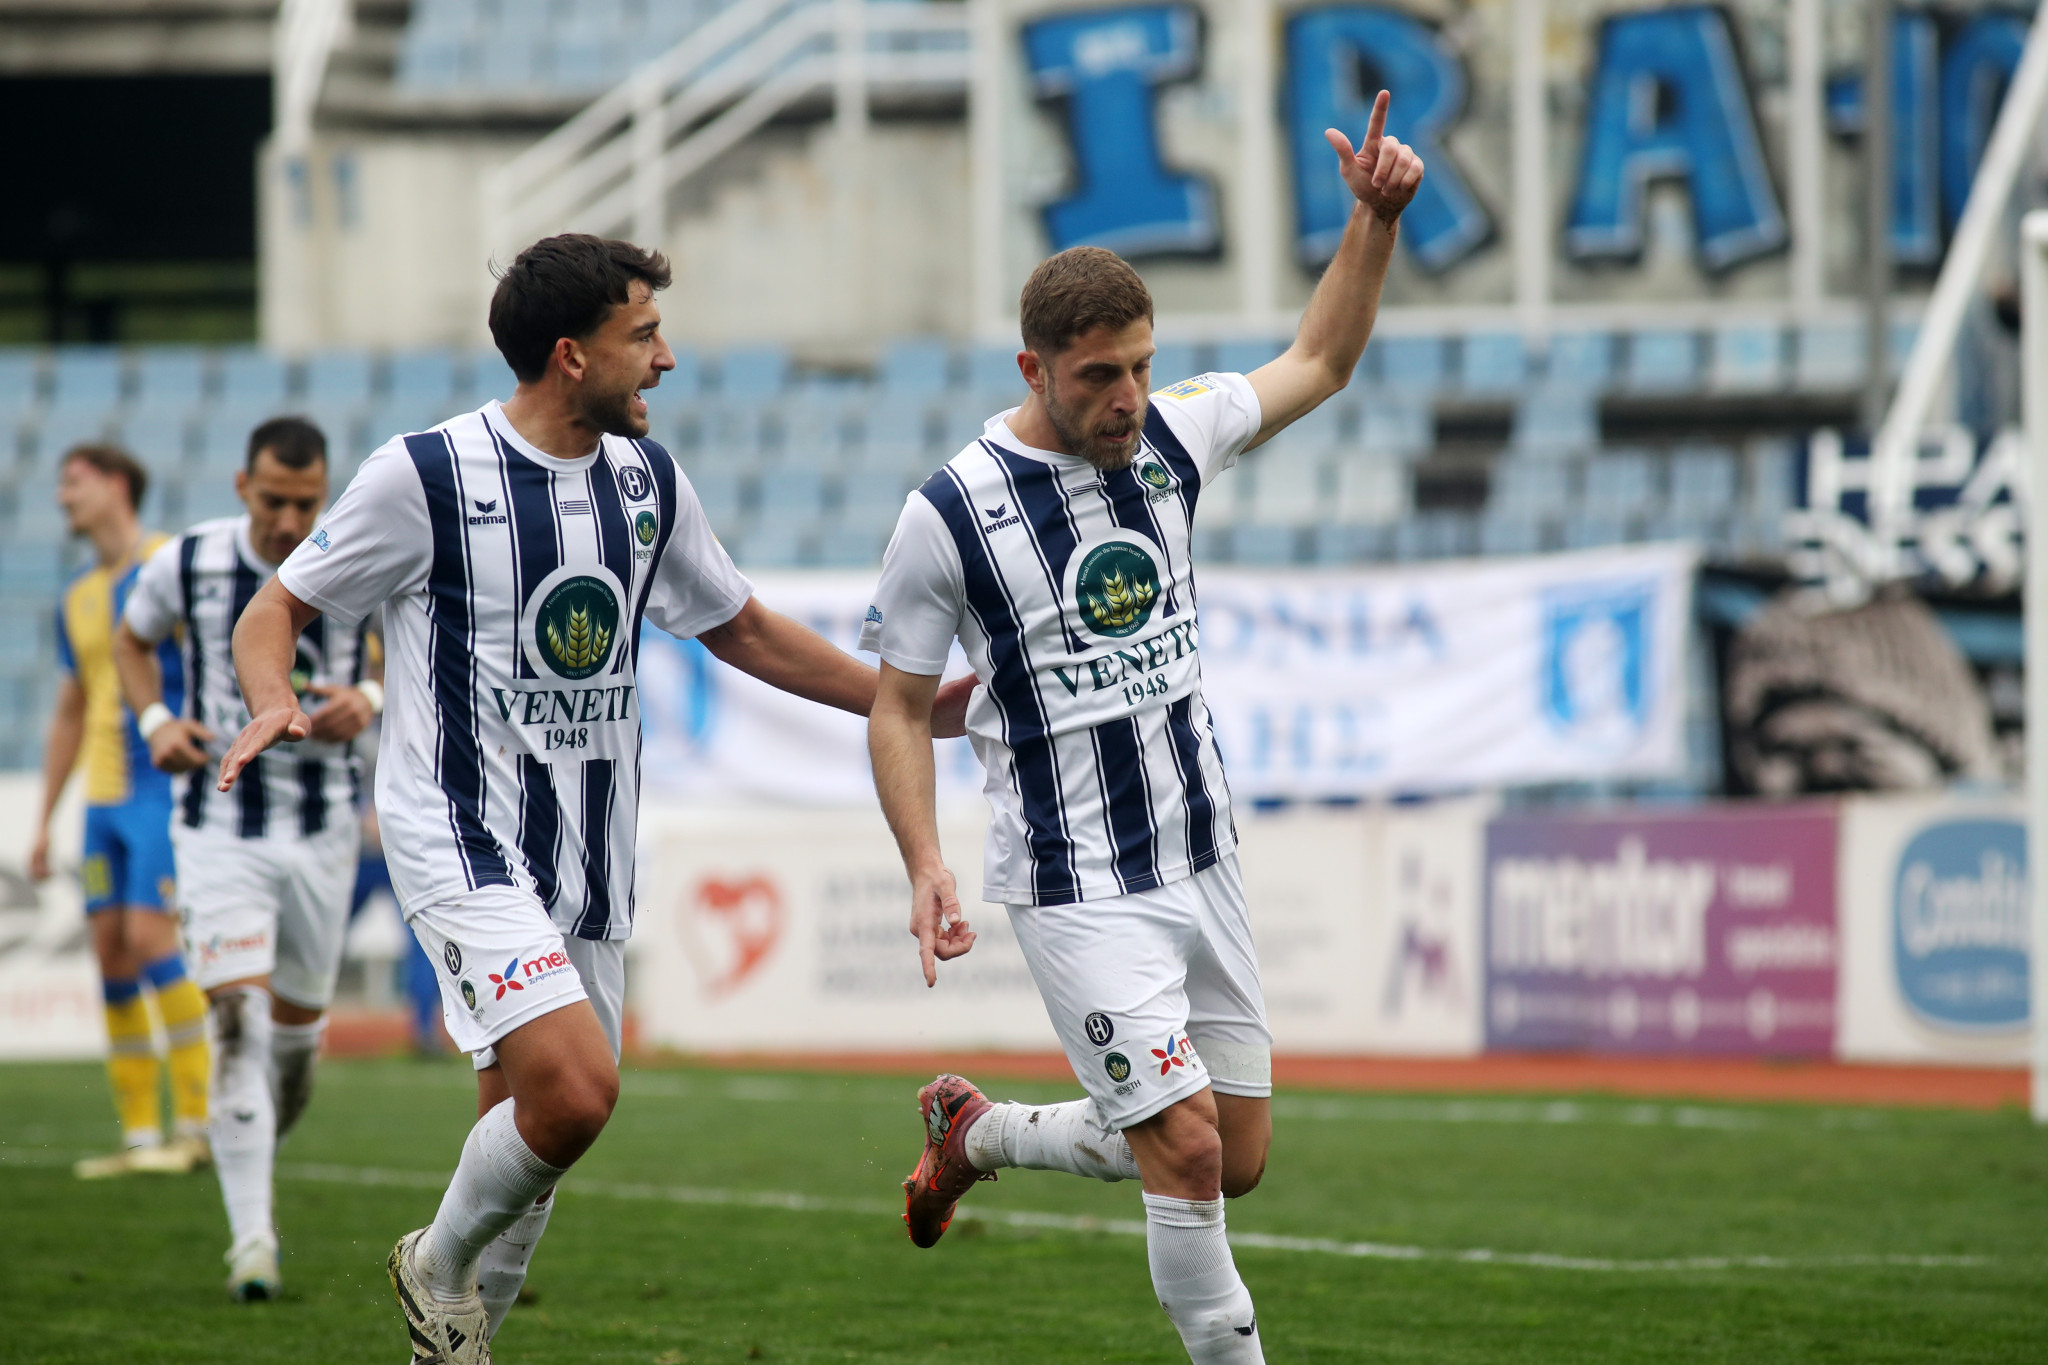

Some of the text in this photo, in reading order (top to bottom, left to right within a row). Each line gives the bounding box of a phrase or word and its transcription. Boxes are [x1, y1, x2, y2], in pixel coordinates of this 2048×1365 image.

[468, 514, 507, 525] erima
[984, 515, 1020, 534] erima
[1050, 619, 1198, 698] VENETI
[1122, 672, 1169, 707] 1948
[490, 685, 635, 725] VENETI
[544, 727, 588, 751] 1948
